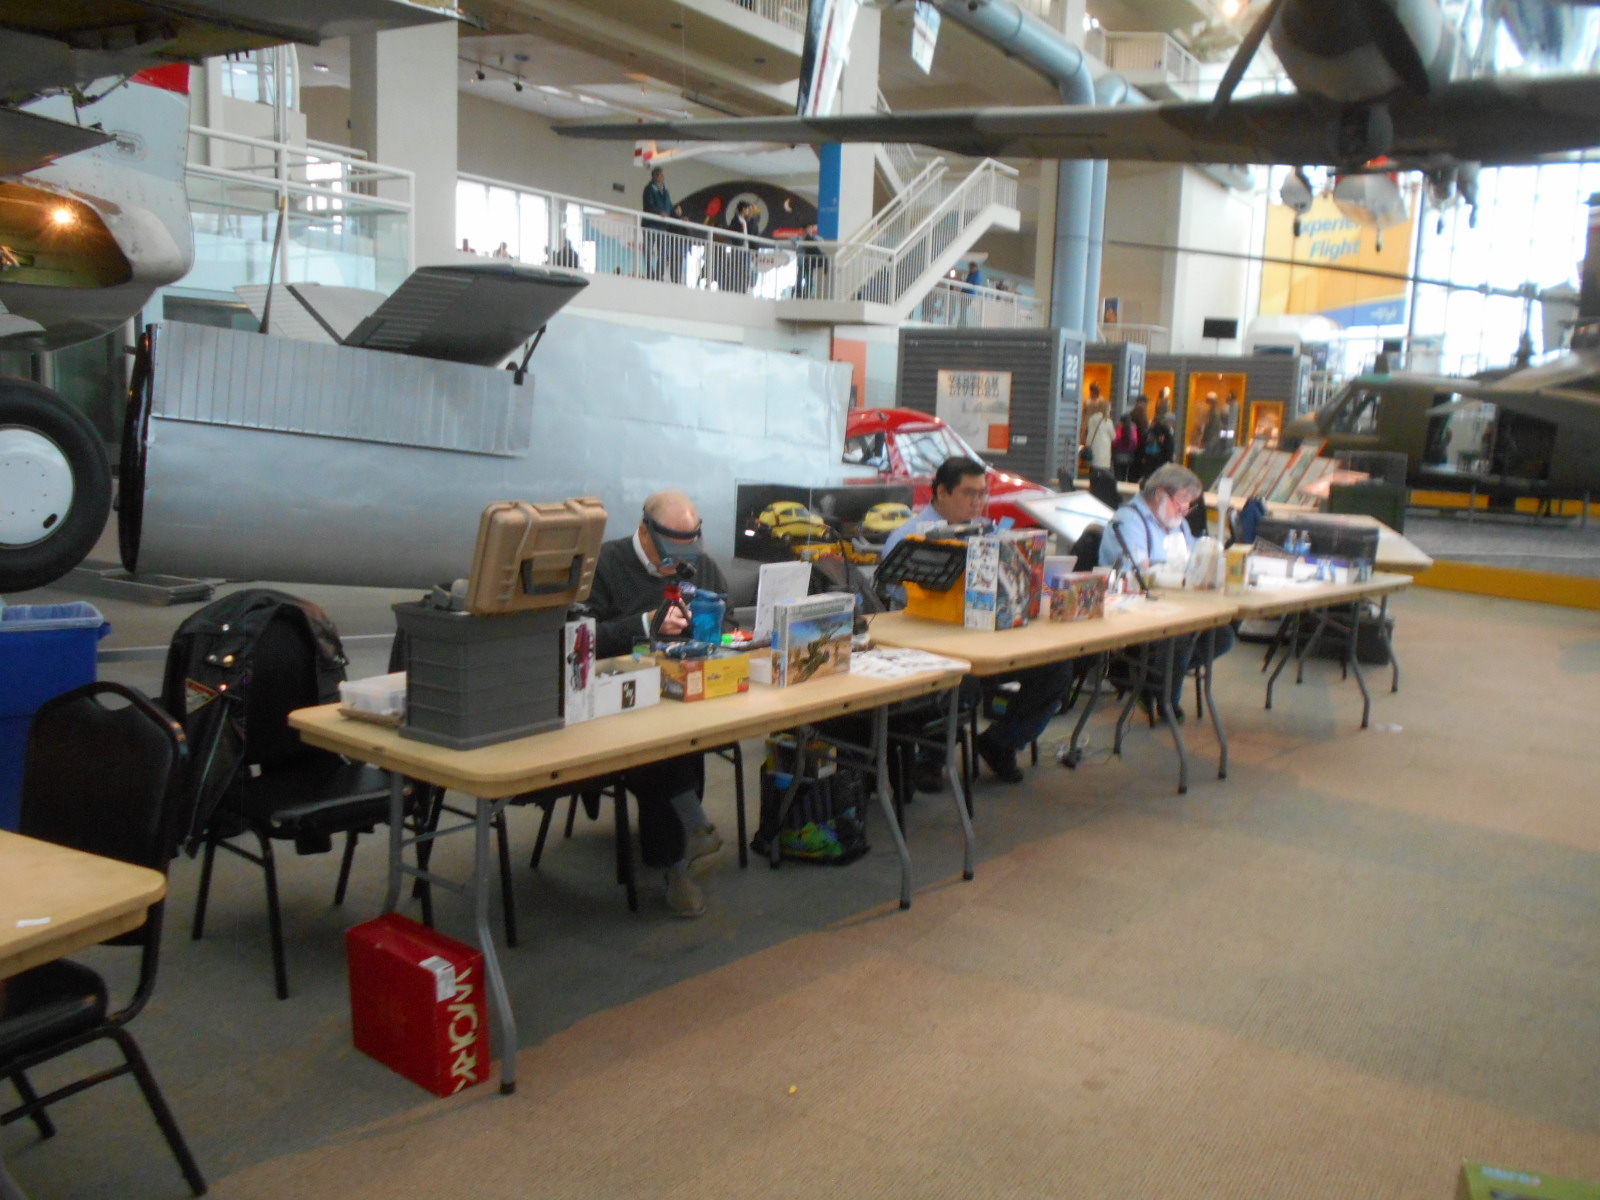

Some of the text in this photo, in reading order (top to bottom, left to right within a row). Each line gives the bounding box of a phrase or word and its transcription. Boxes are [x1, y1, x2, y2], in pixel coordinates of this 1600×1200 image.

[1309, 238, 1361, 264] Flight
[1065, 354, 1079, 380] 22
[1131, 365, 1141, 387] 23
